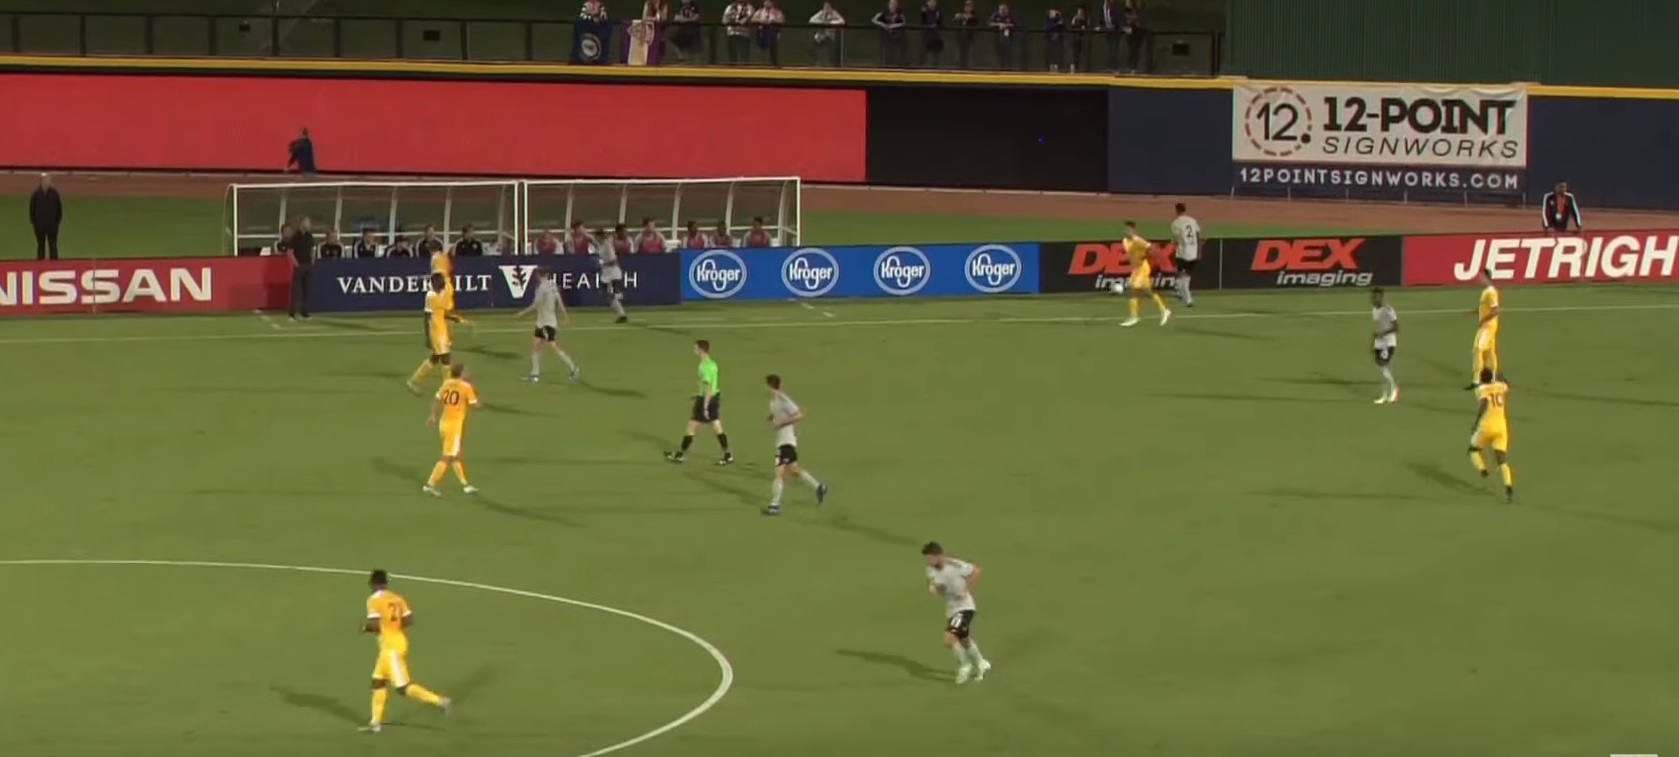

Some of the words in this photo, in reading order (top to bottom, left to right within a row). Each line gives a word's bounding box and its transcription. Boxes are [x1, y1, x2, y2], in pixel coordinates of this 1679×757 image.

[1323, 97, 1517, 135] 12-POINT
[1322, 136, 1519, 158] SIGNWORKS
[1239, 168, 1519, 189] 12POINTSIGNWORKS.COM
[972, 253, 1016, 286] Kroger
[1252, 238, 1365, 272] DEX
[1454, 235, 1679, 281] JETRIGH
[337, 274, 492, 294] VANDERILT
[696, 259, 741, 291] Kroger
[788, 257, 834, 289] Kroger
[881, 256, 926, 288] Kroger
[1276, 270, 1373, 287] imaging
[443, 390, 459, 406] 20
[1489, 393, 1503, 407] 10
